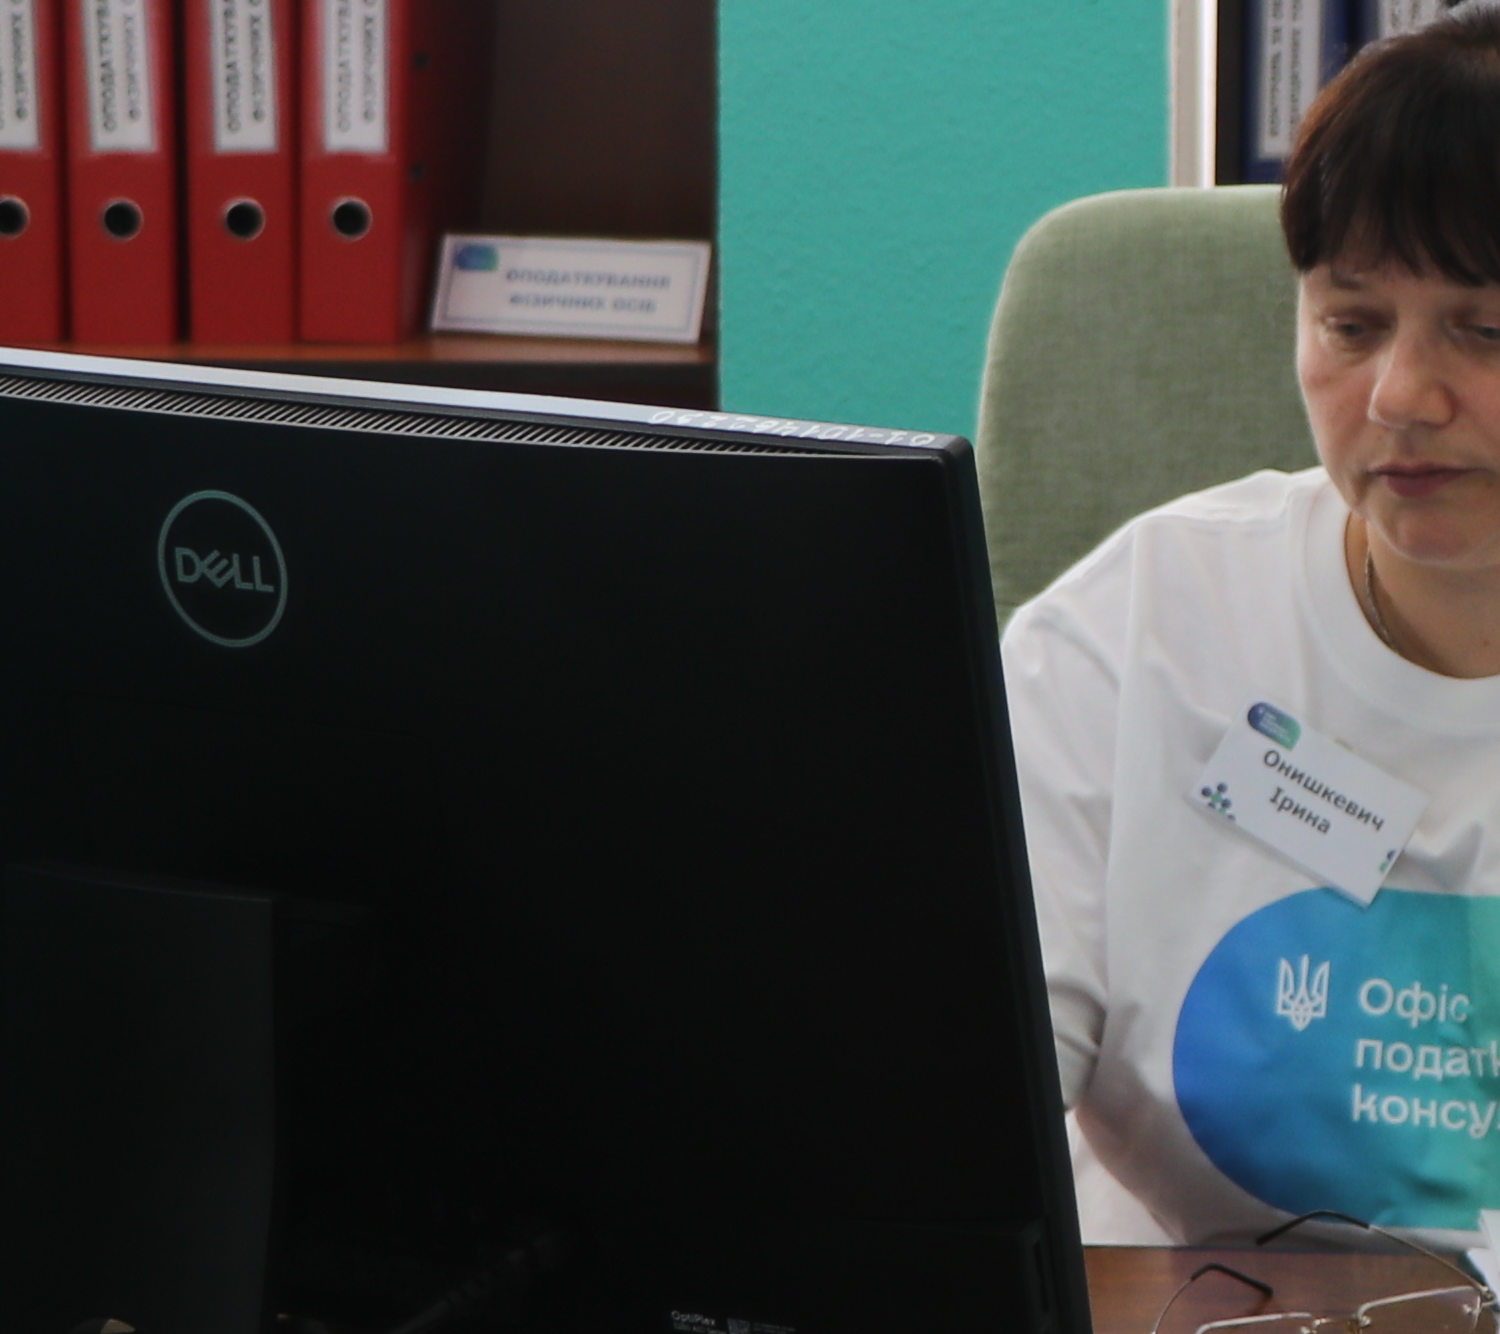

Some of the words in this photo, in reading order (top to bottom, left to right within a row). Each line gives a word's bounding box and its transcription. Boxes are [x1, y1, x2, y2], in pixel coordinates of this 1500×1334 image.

[175, 547, 275, 593] DELL
[1261, 748, 1386, 833] Онишкевич
[1269, 787, 1333, 837] Ірина
[1359, 977, 1473, 1029] Офіс
[671, 1310, 717, 1327] OptiPlex
